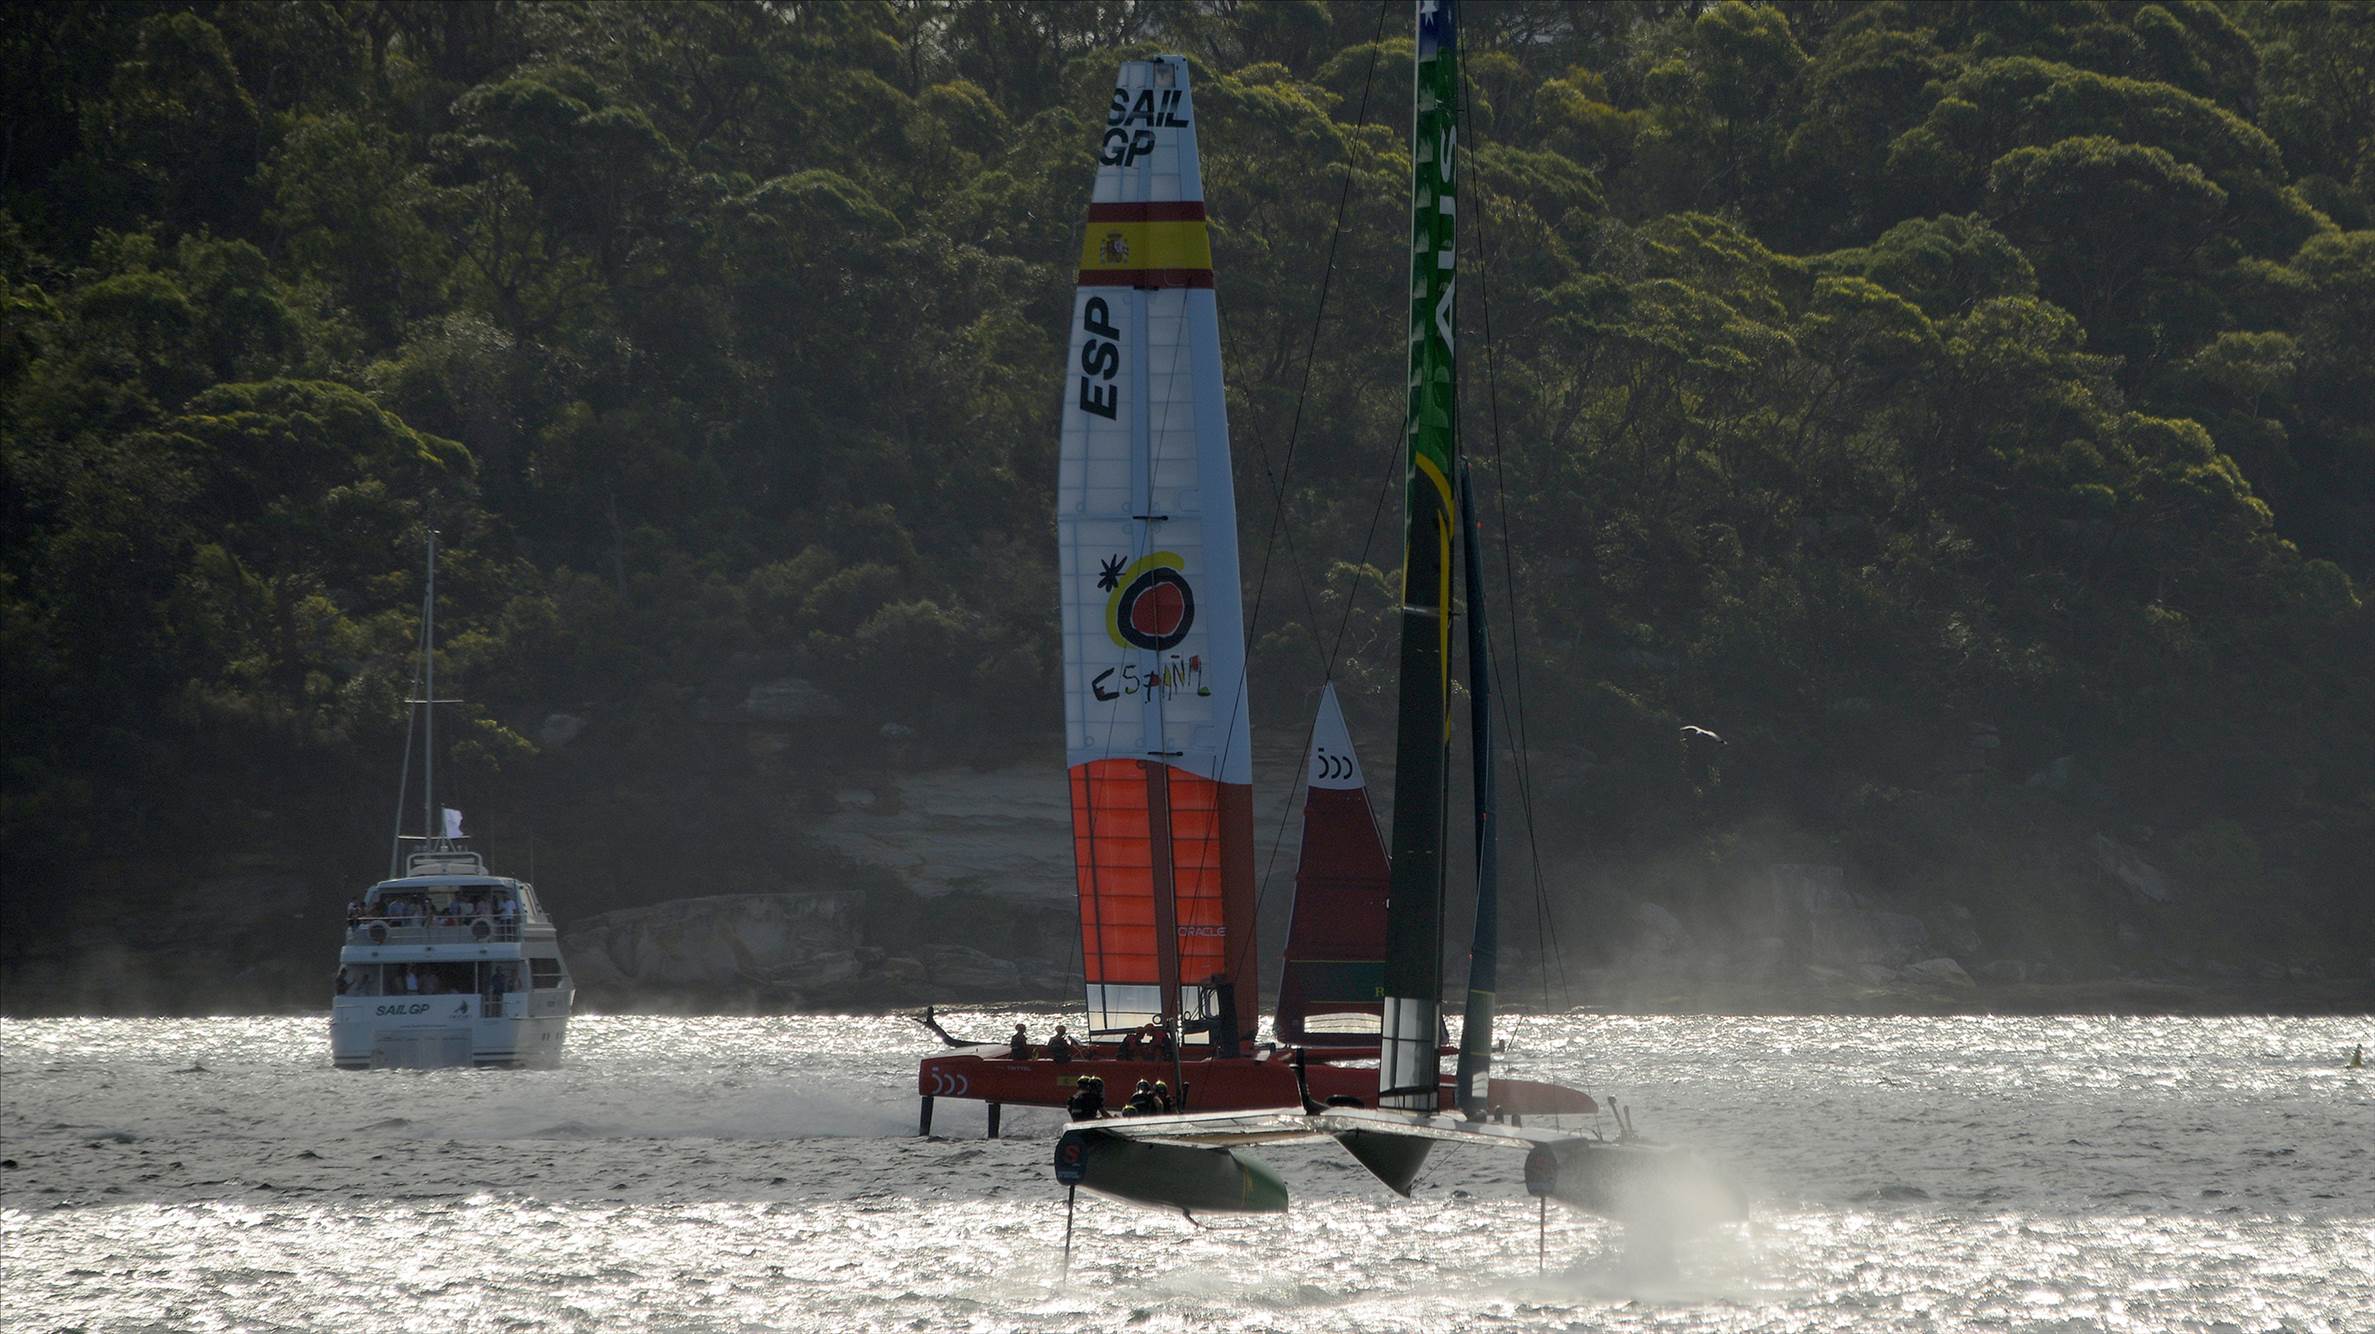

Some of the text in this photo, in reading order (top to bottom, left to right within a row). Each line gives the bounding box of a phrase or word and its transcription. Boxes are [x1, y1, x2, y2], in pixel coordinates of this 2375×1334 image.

[1107, 88, 1189, 127] SAIL
[1100, 128, 1156, 167] GP
[1080, 296, 1120, 421] ESP
[1177, 926, 1228, 937] ORACLE
